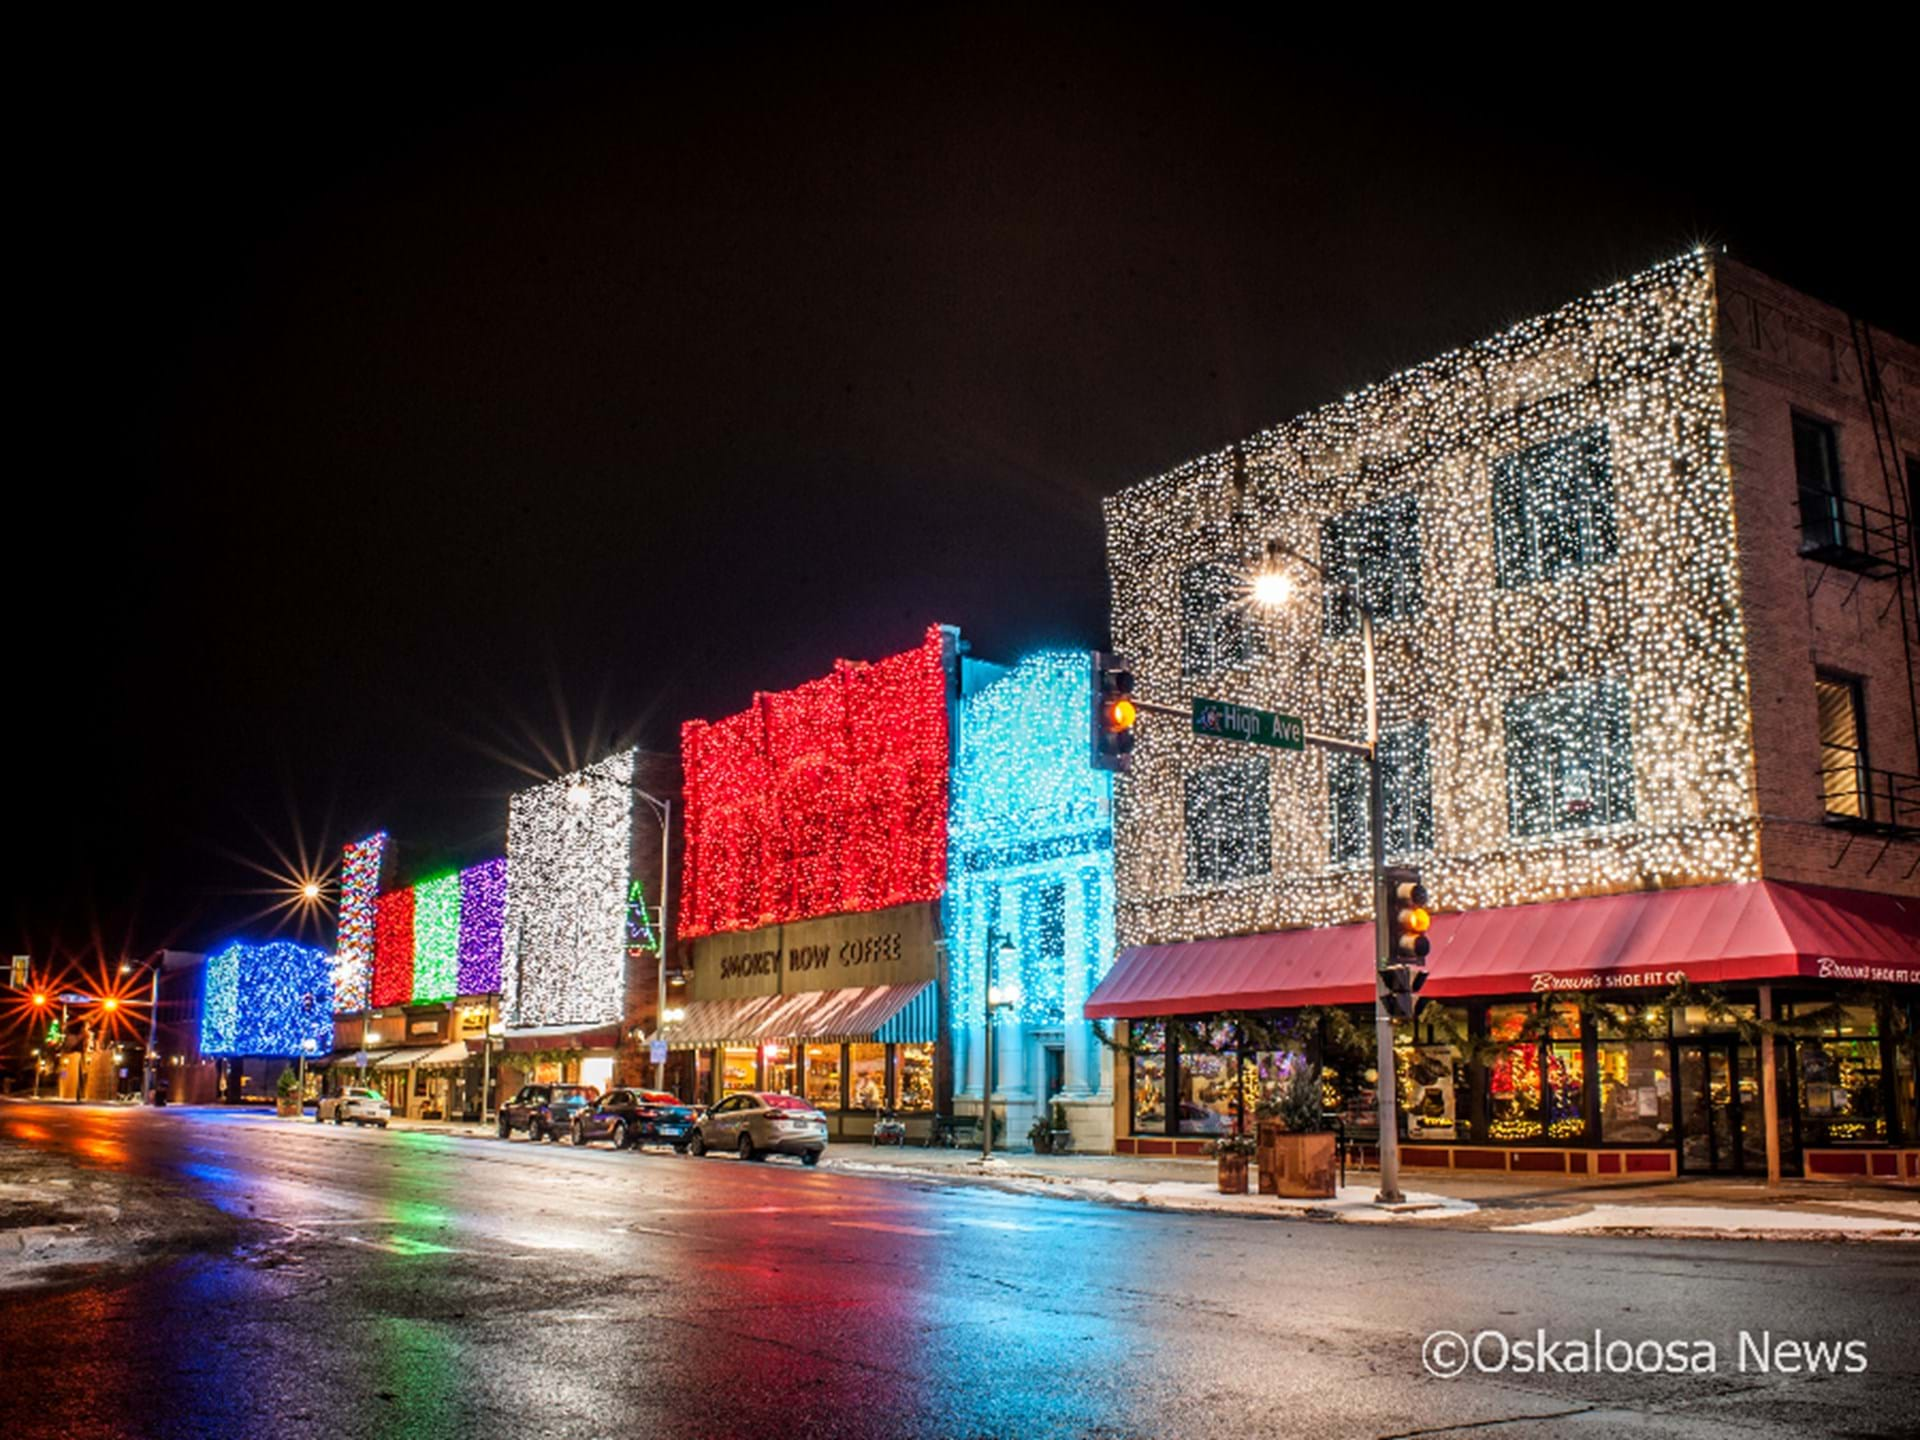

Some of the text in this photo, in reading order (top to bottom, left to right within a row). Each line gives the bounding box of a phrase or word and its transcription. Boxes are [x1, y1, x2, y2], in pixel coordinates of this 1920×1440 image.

[1223, 706, 1301, 742] High Ave
[720, 933, 902, 980] SMOKEY ROW COFFEE
[1530, 973, 1601, 992] Brown's
[1605, 974, 1641, 987] SHOE
[1644, 972, 1664, 985] FIT
